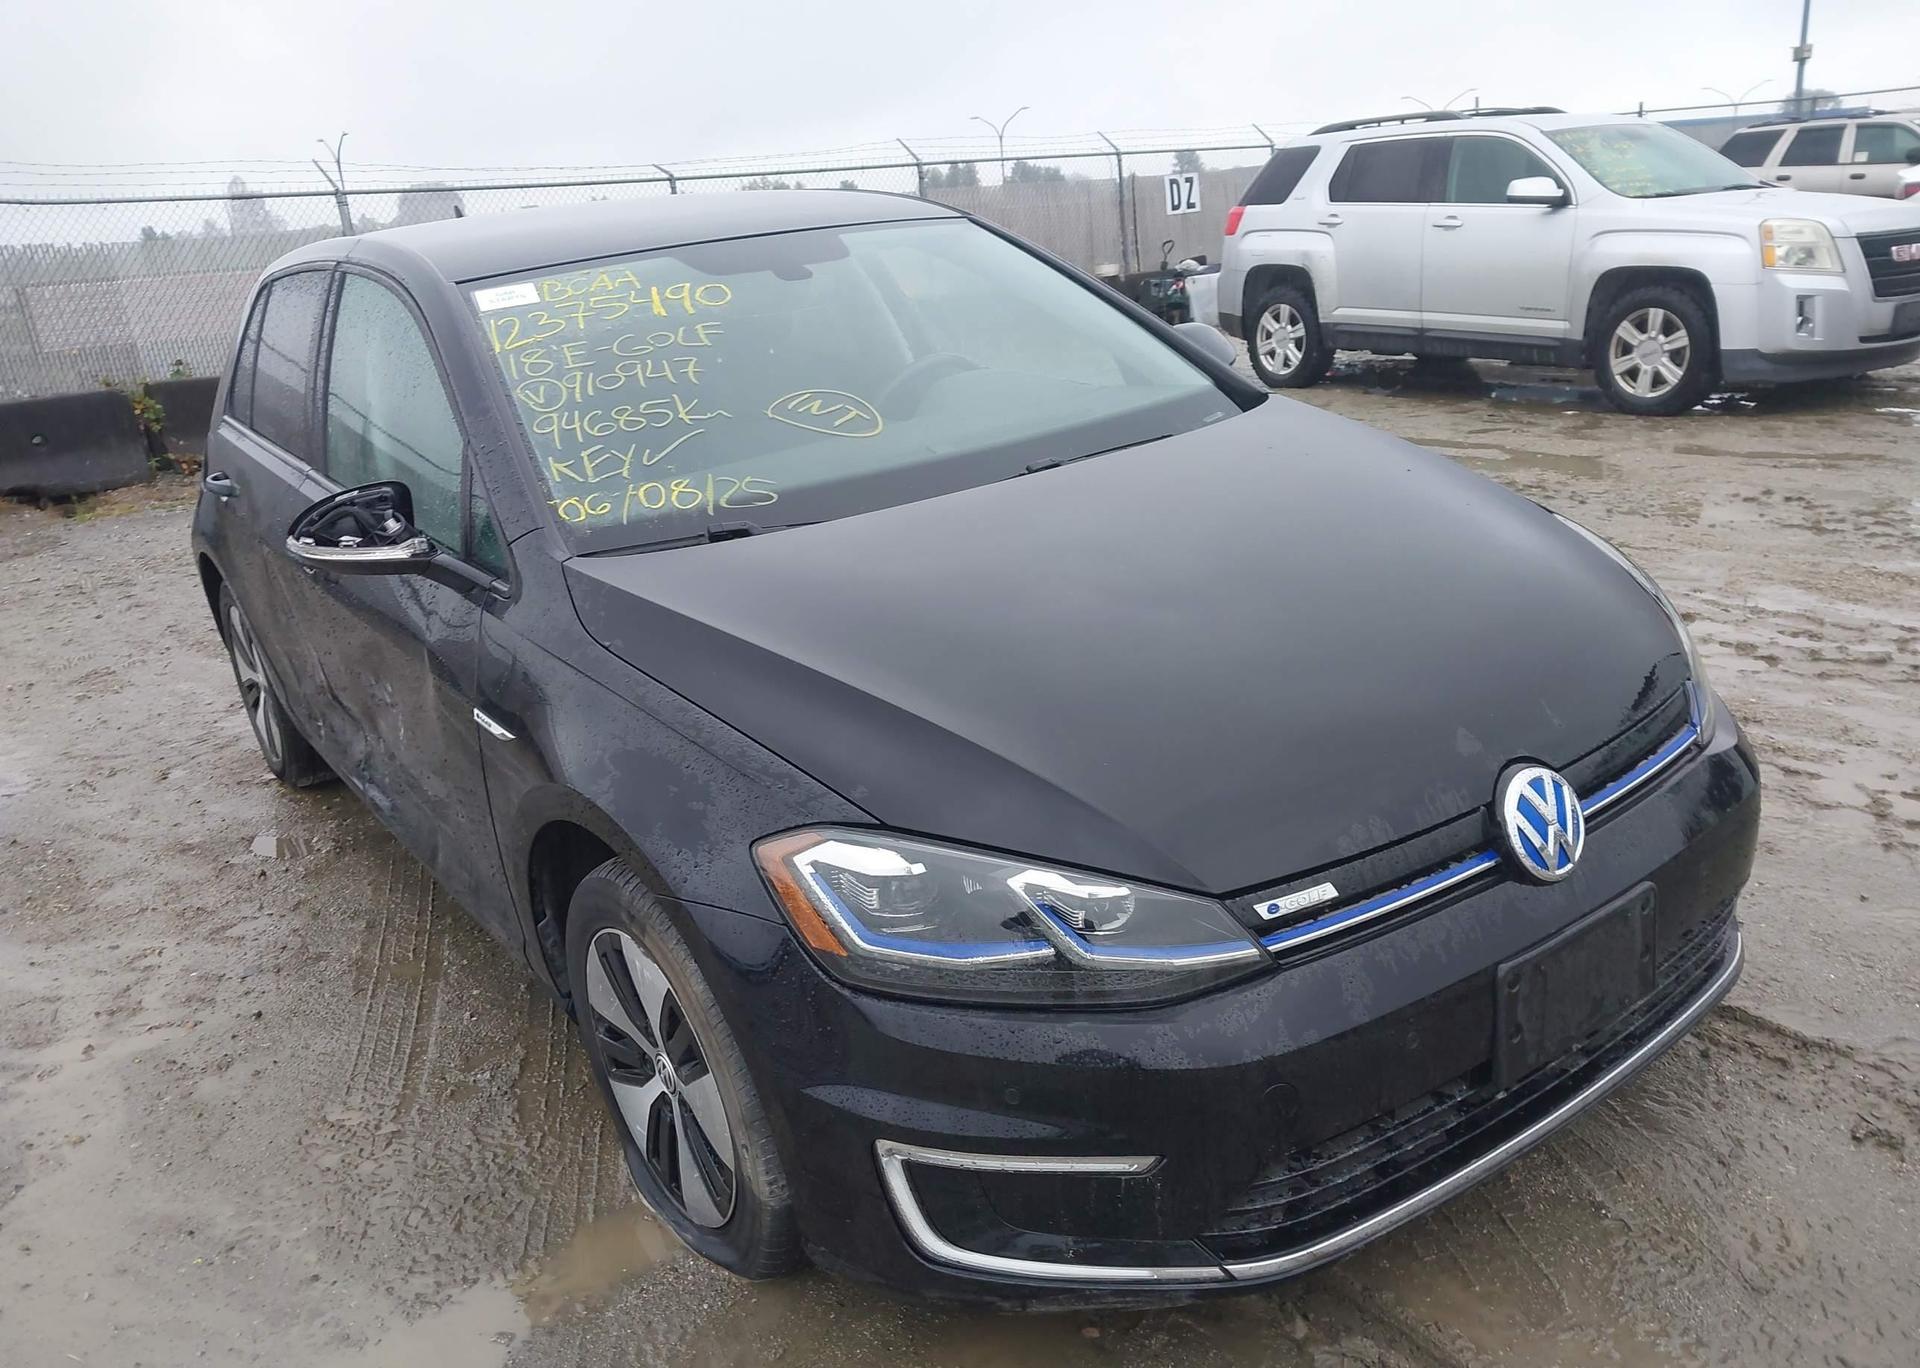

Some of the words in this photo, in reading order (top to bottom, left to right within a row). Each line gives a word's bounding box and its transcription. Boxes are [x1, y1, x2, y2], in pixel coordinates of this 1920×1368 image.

[1169, 176, 1196, 211] DZ
[543, 270, 641, 301] BCAA
[562, 357, 704, 402] 910947
[788, 394, 871, 427] INT
[549, 443, 635, 483] KEY
[557, 473, 778, 526] 06/08/25
